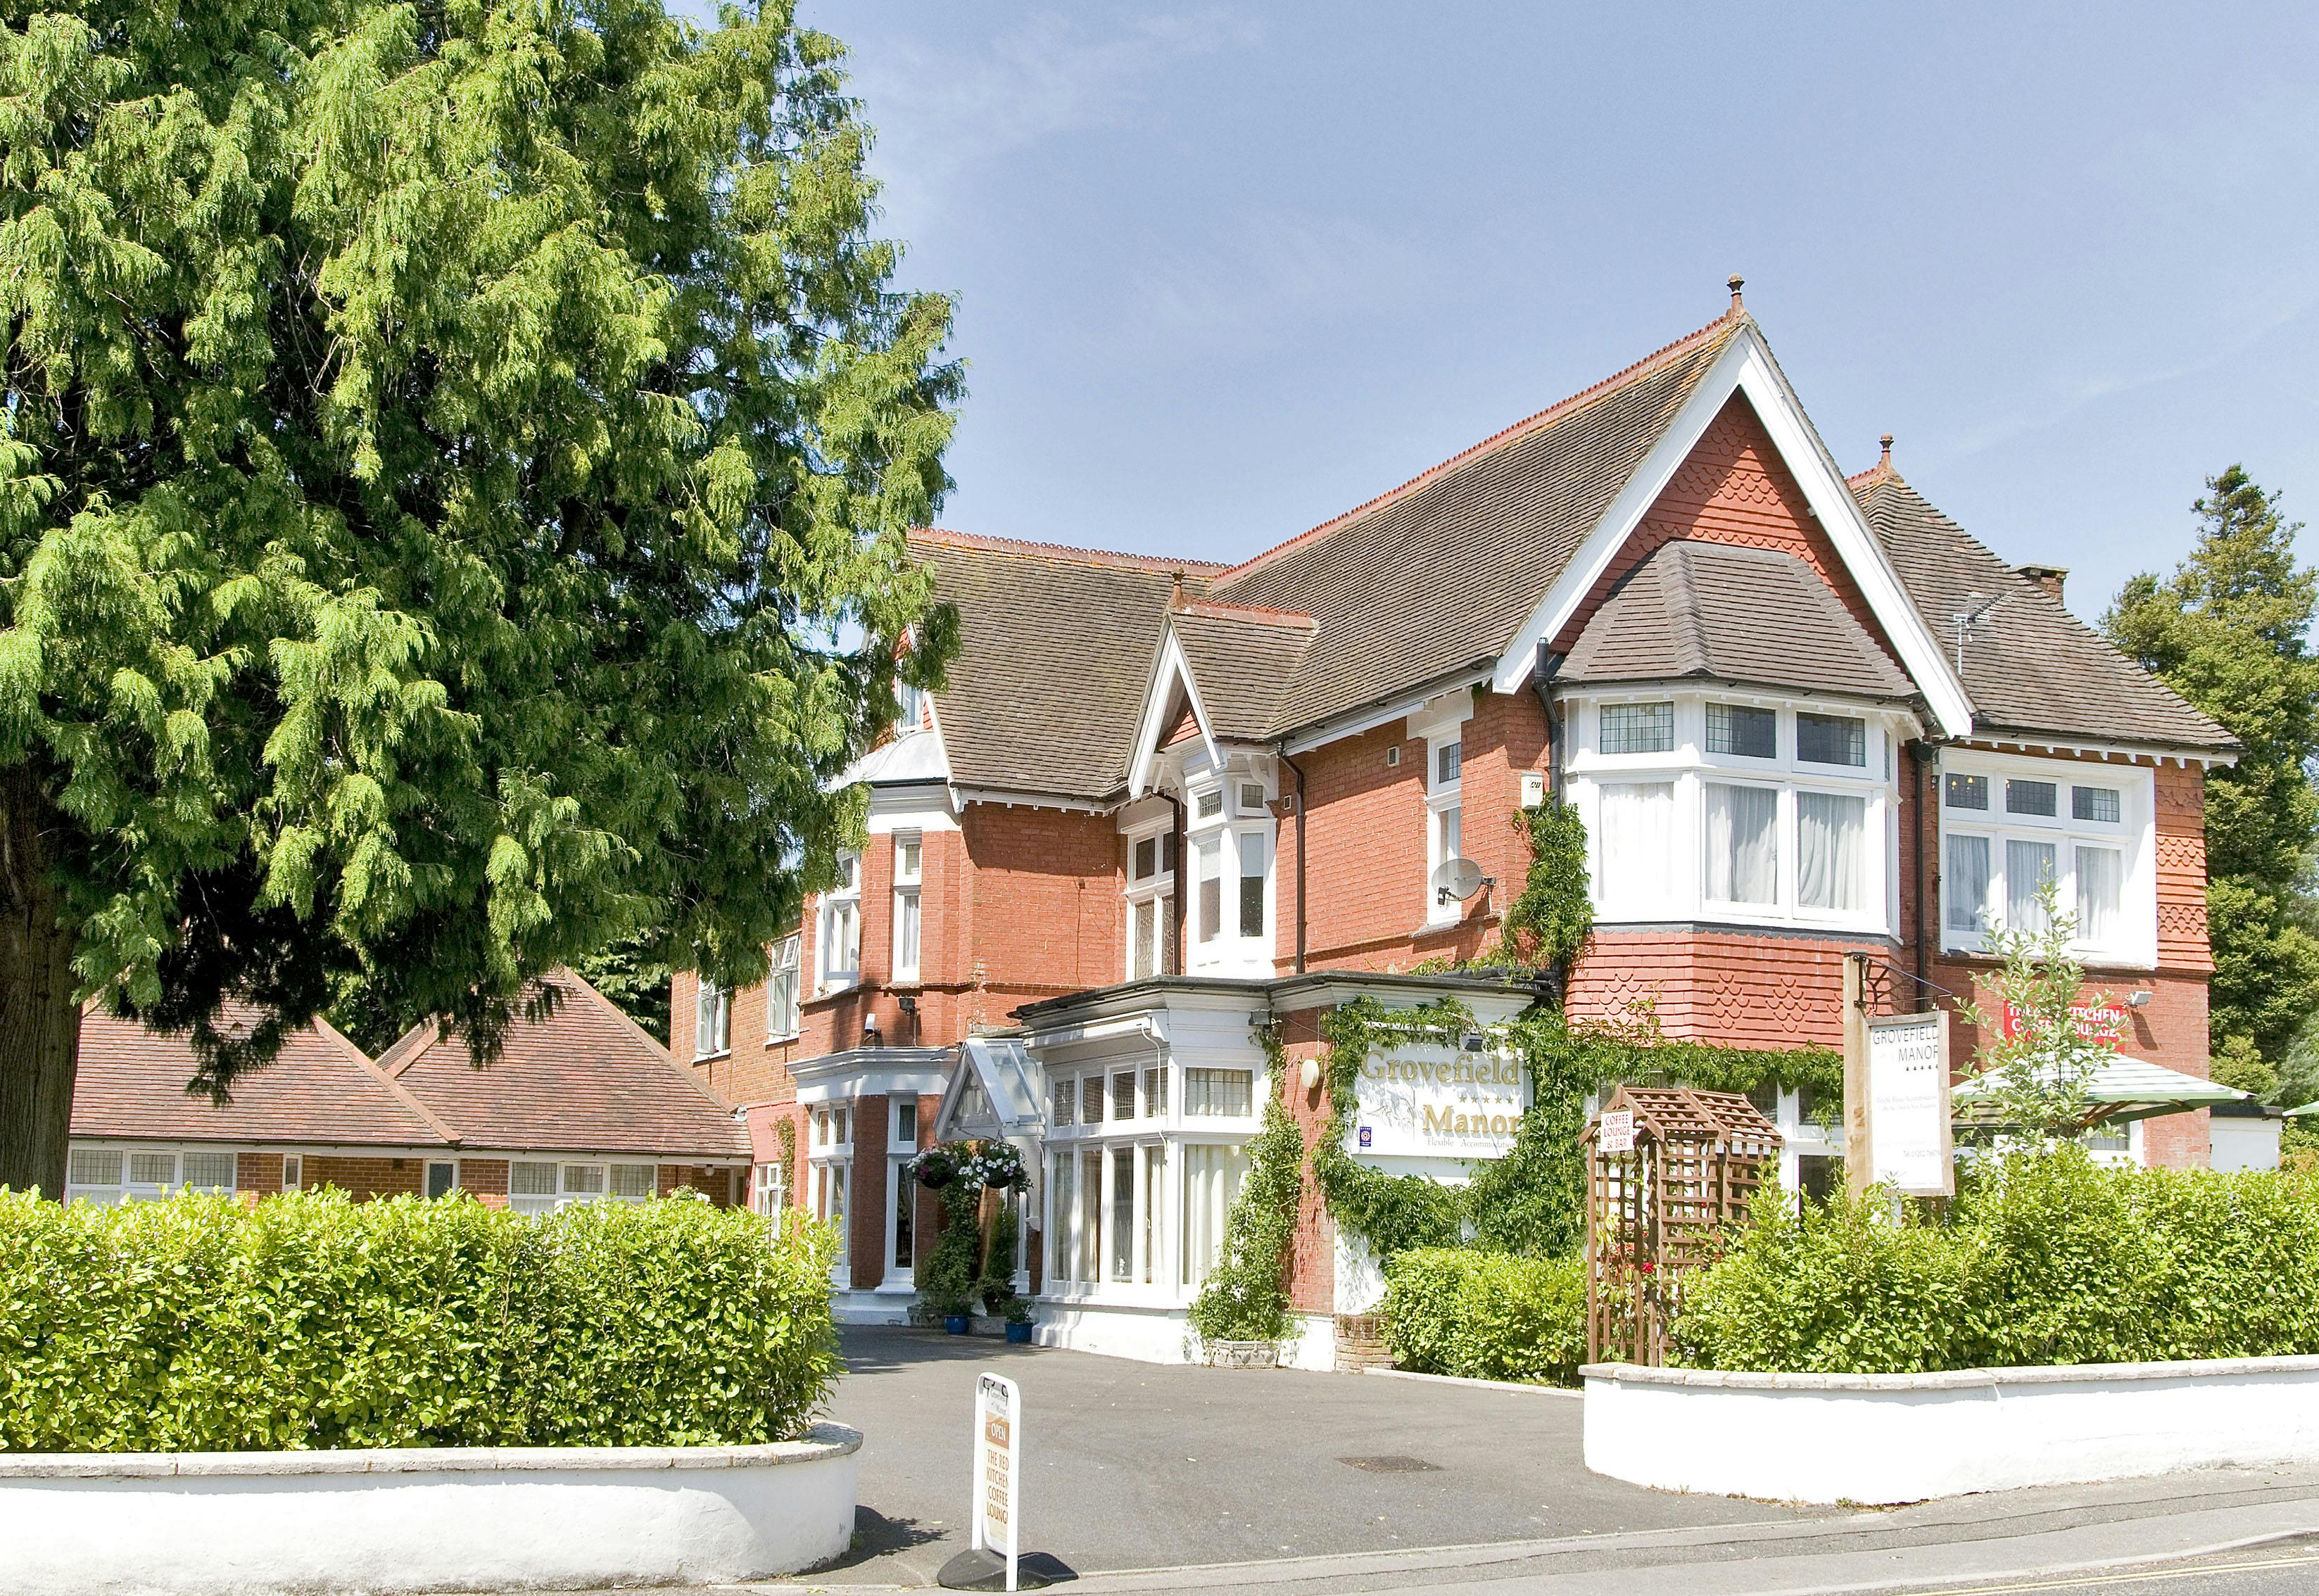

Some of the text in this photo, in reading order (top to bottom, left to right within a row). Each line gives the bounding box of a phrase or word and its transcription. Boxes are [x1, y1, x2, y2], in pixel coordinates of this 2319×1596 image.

[1360, 1051, 1519, 1084] Grovefield
[1422, 1104, 1521, 1135] Manor
[1605, 1114, 1629, 1125] COFFEE
[1604, 1126, 1630, 1137] LOUNGE
[1427, 1137, 1454, 1146] Flexible
[1607, 1138, 1627, 1148] & BAR
[991, 1422, 1006, 1441] OPEN
[987, 1449, 1009, 1471] THE RED
[988, 1486, 1008, 1507] COFFEE
